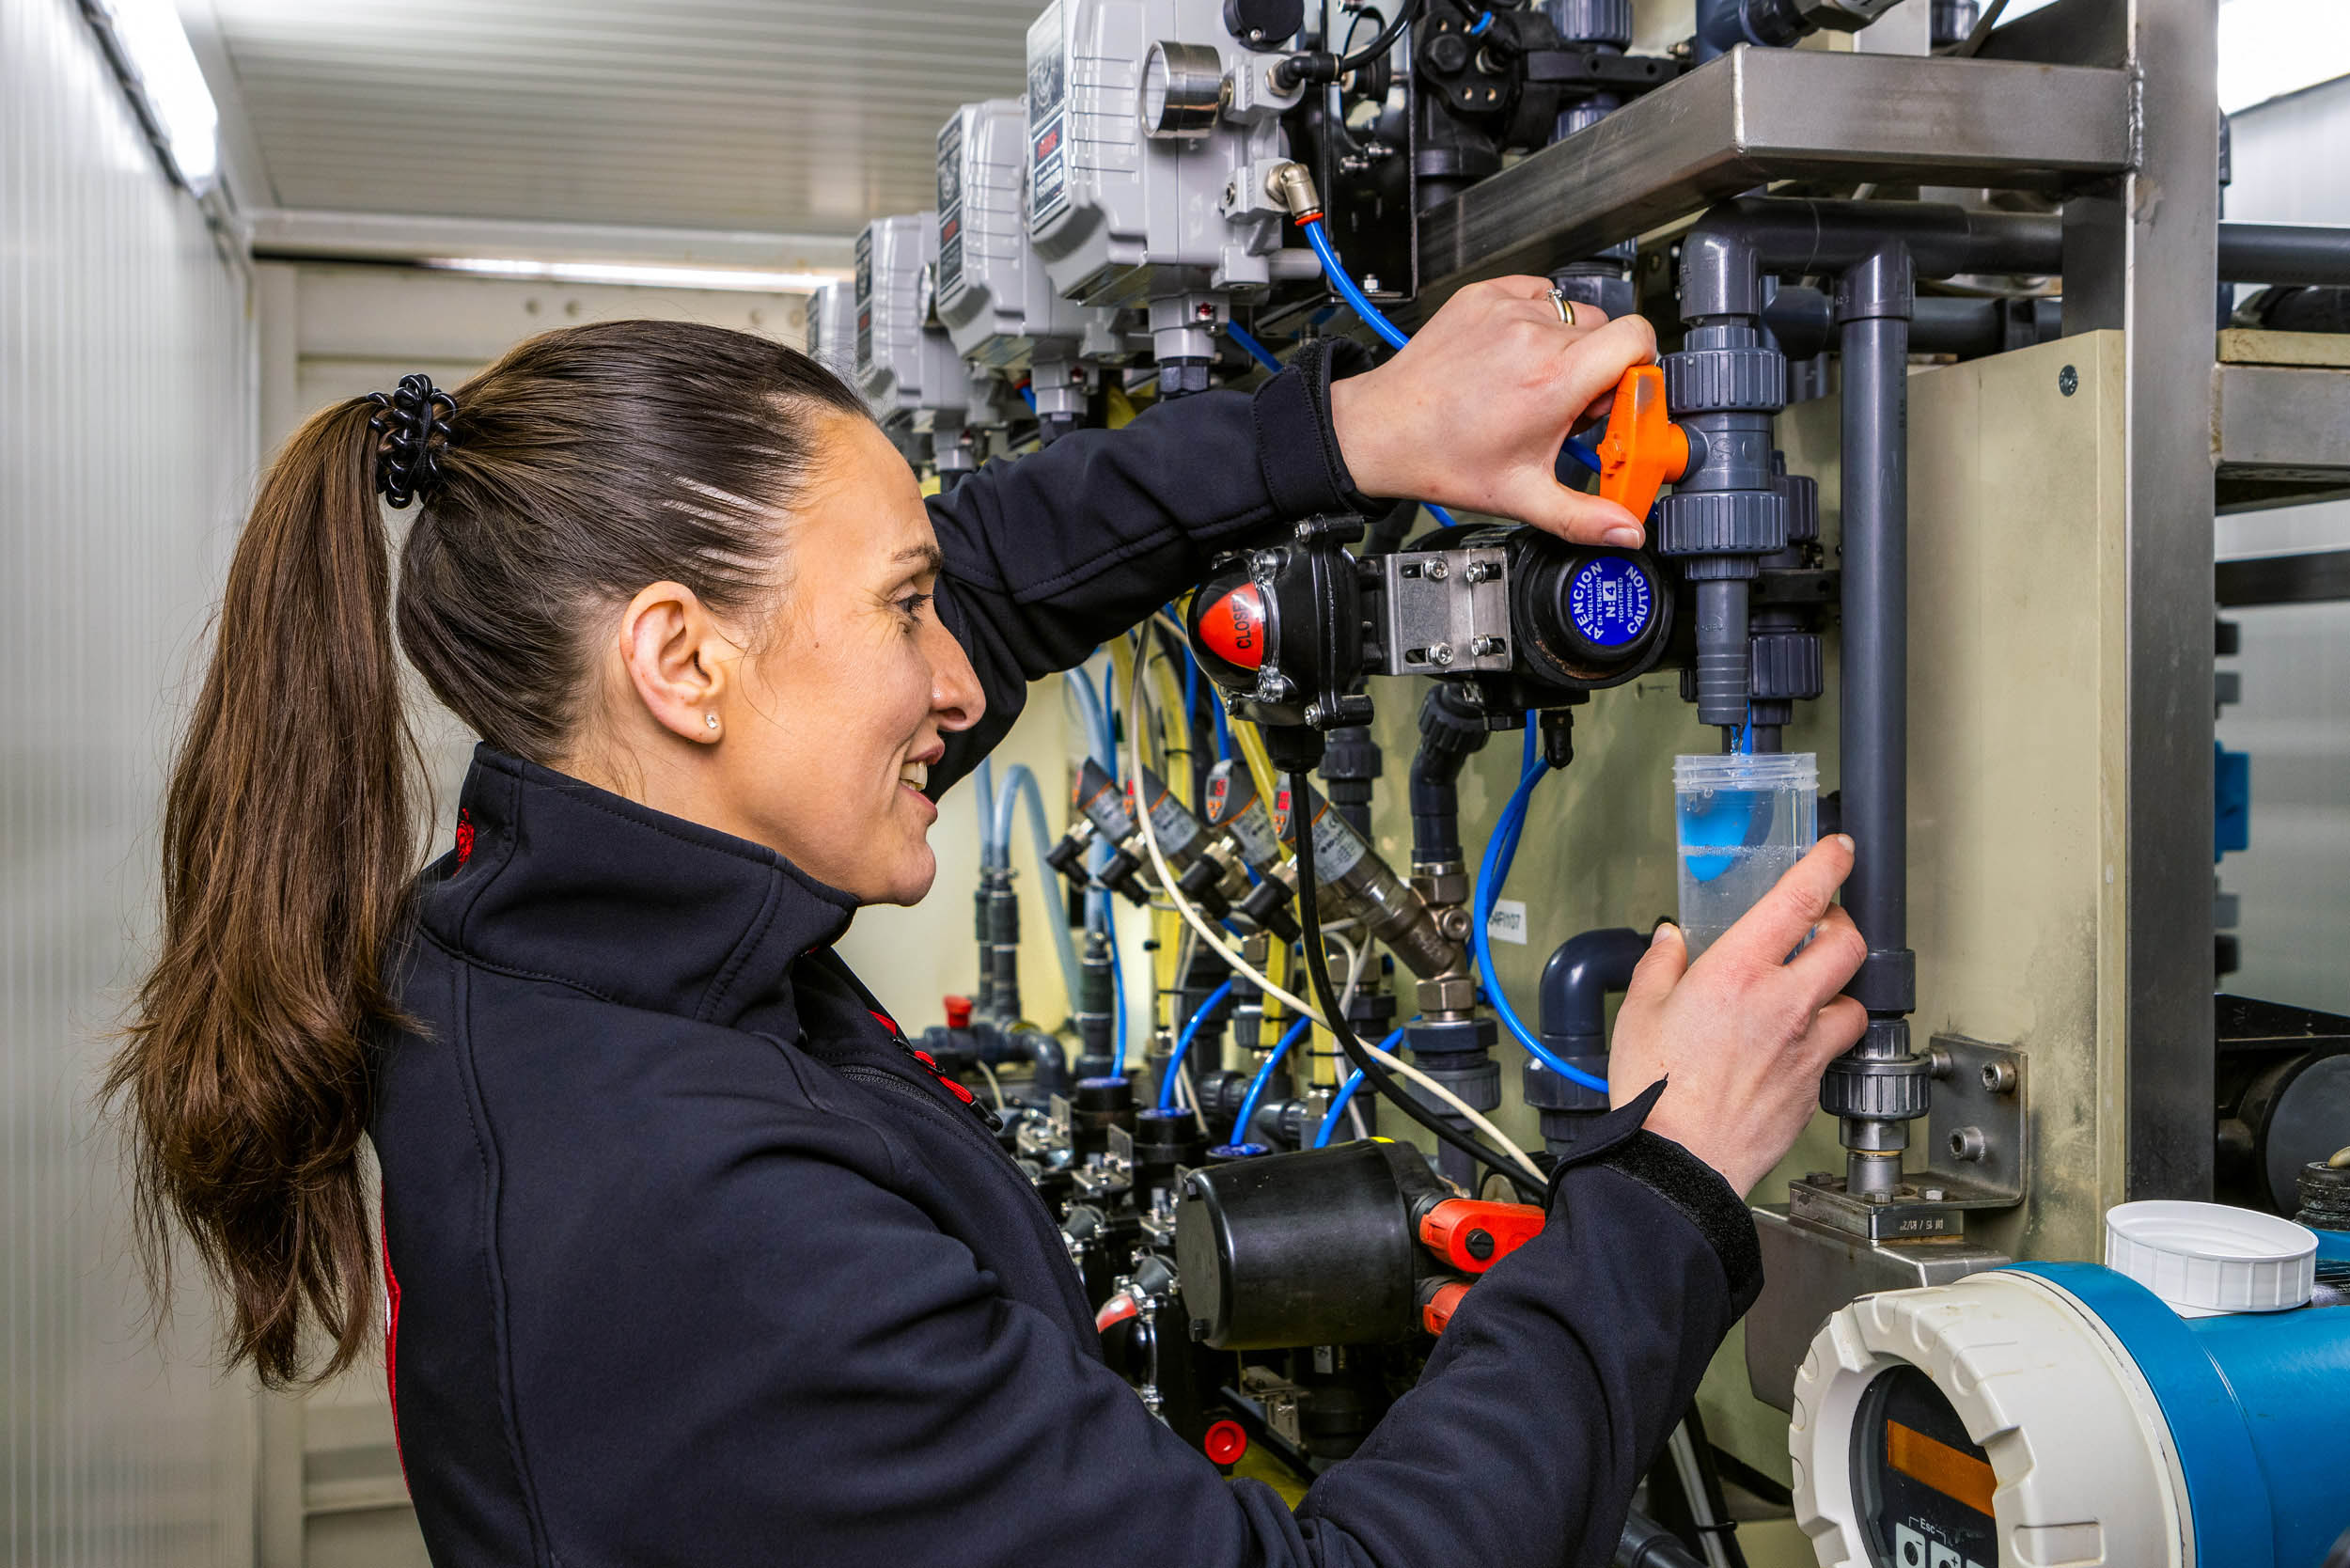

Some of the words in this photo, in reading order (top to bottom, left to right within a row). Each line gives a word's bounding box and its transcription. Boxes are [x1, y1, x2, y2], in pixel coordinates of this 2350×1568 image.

[1573, 562, 1605, 640] ATENCION
[1597, 615, 1603, 626] EN
[1625, 566, 1649, 635] CAUTION
[1919, 1518, 1935, 1534] Esc
